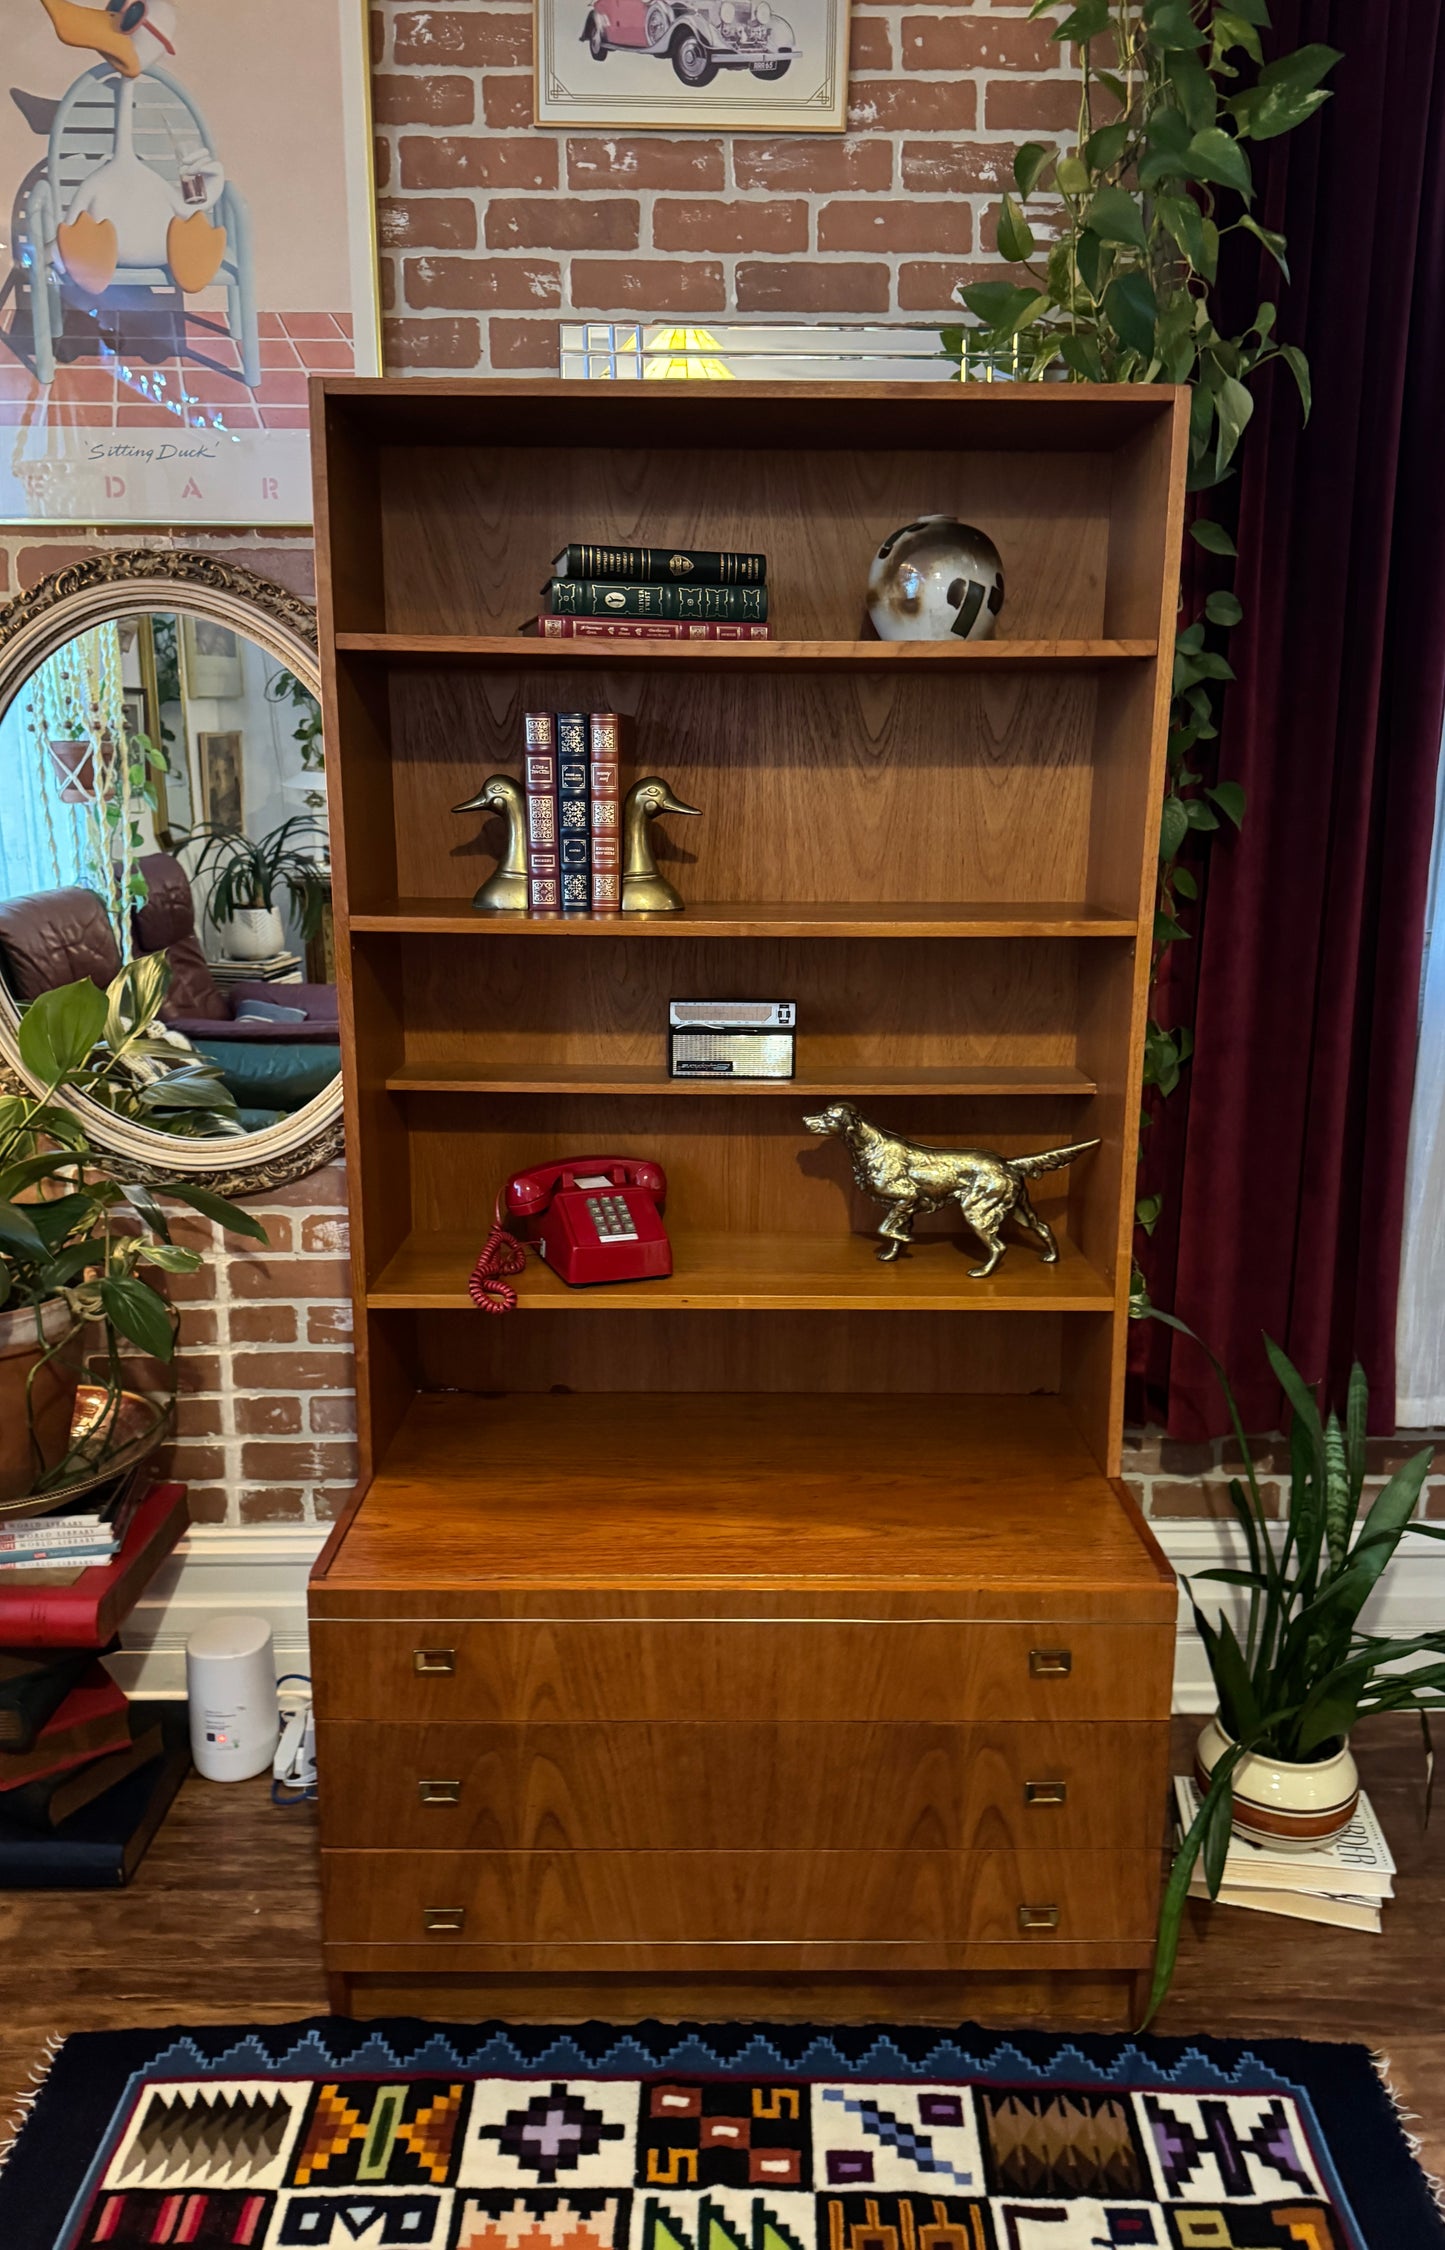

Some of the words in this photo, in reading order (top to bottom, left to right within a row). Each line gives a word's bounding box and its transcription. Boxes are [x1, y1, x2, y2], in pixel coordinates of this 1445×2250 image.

[17, 1530, 52, 1539] WORLD
[57, 1529, 94, 1537] LIBRARY
[20, 1540, 53, 1548] WORLD
[58, 1537, 95, 1546] LIBRARY
[58, 1559, 95, 1567] LIBRARY
